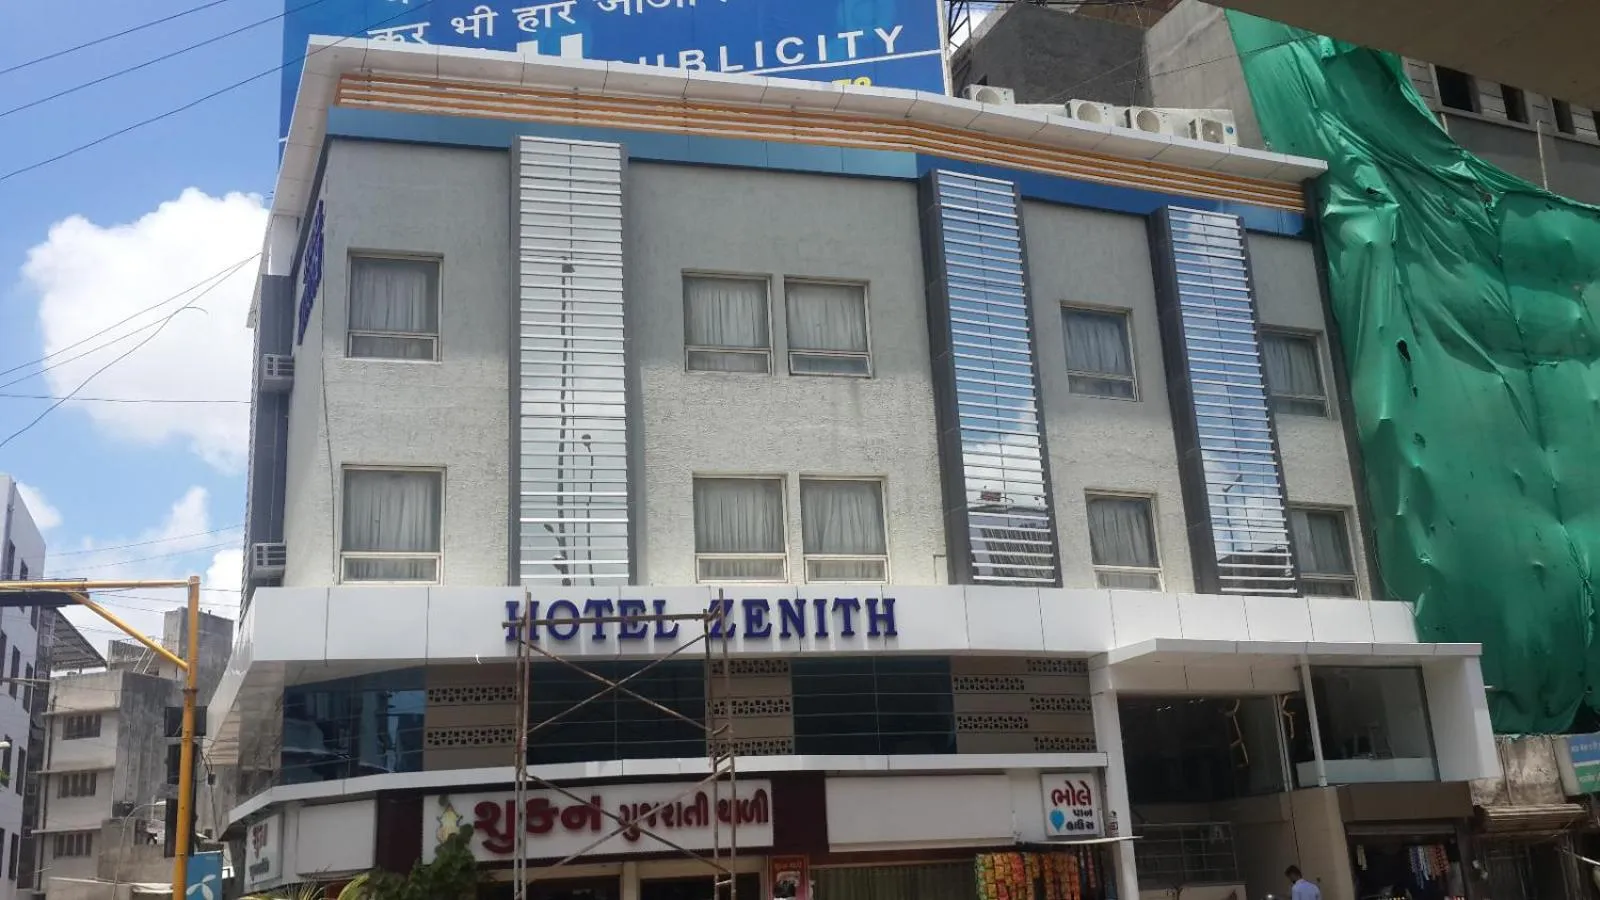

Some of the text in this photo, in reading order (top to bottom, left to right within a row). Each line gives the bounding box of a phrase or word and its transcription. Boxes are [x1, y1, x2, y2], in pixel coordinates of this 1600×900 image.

[451, 5, 498, 38] भी
[512, 1, 577, 33] हार
[611, 25, 903, 73] BLICITY
[505, 597, 898, 642] HOTEL ZENITH
[1051, 780, 1092, 807] ભોલે
[474, 796, 602, 854] શુકન
[619, 790, 709, 842] ગુજરાતી
